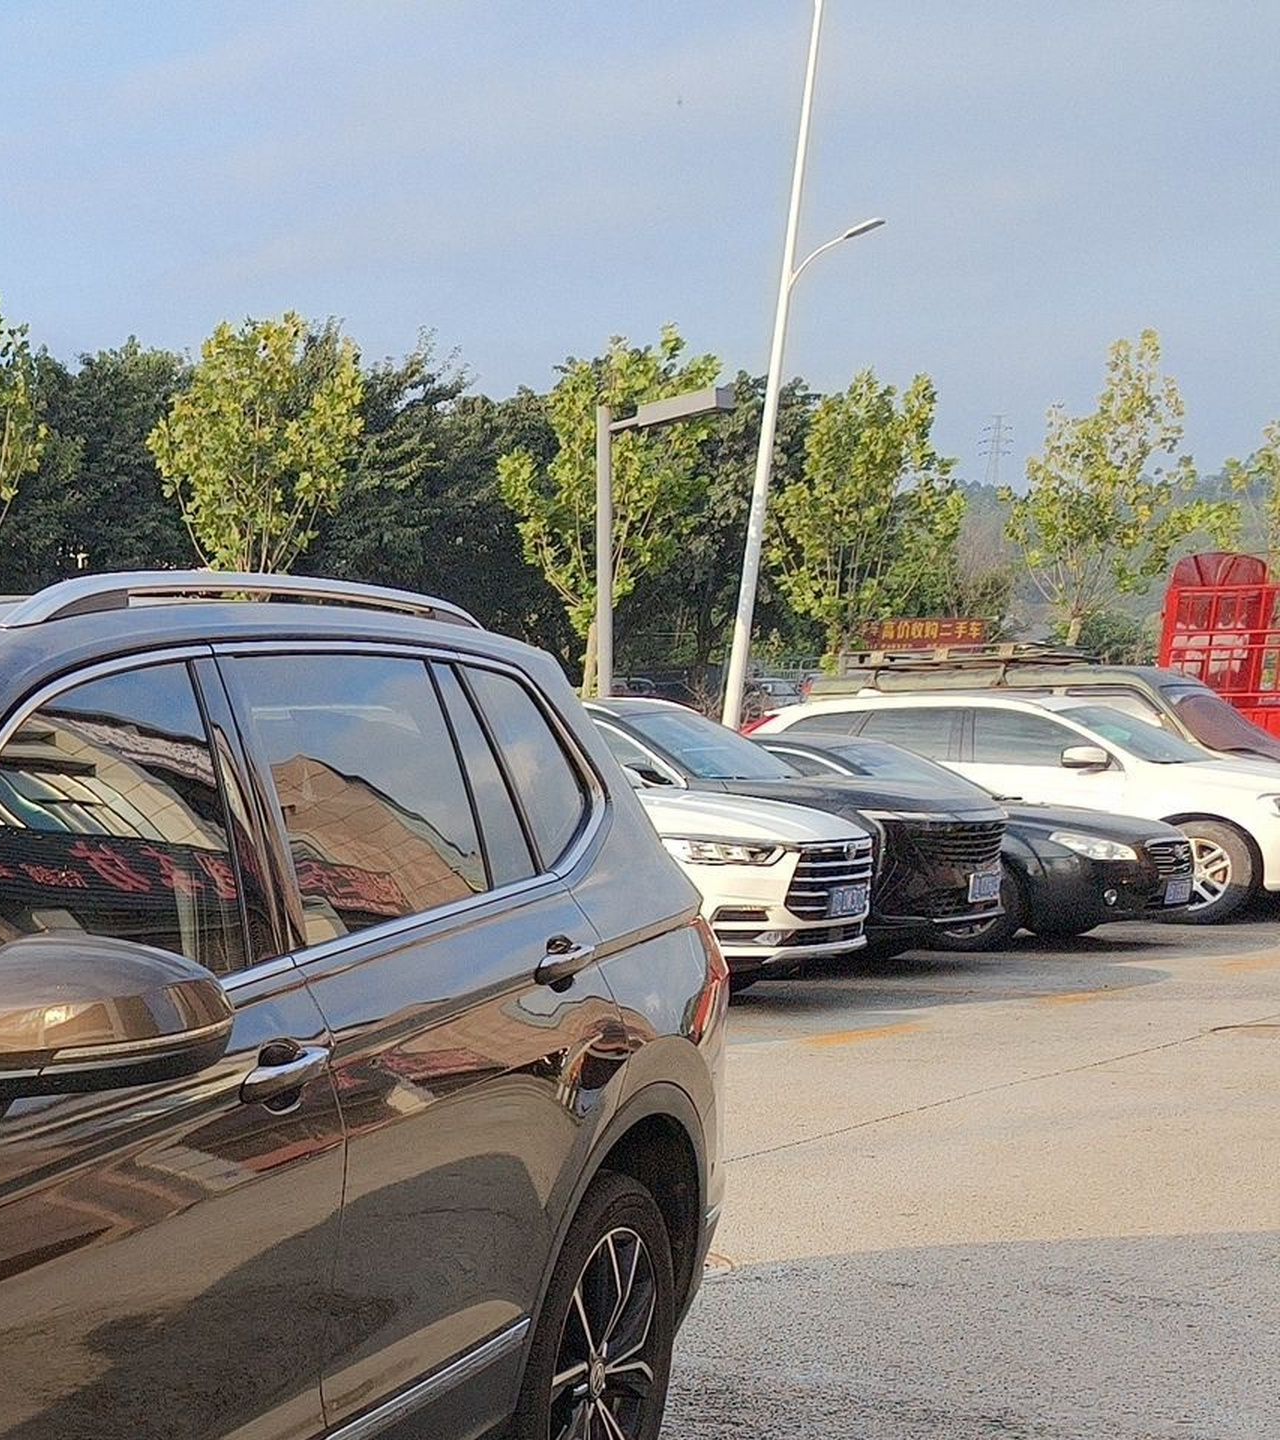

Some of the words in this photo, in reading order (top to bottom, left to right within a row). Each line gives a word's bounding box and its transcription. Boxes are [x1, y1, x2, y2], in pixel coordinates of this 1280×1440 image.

[881, 620, 982, 640] 高价收购二手车
